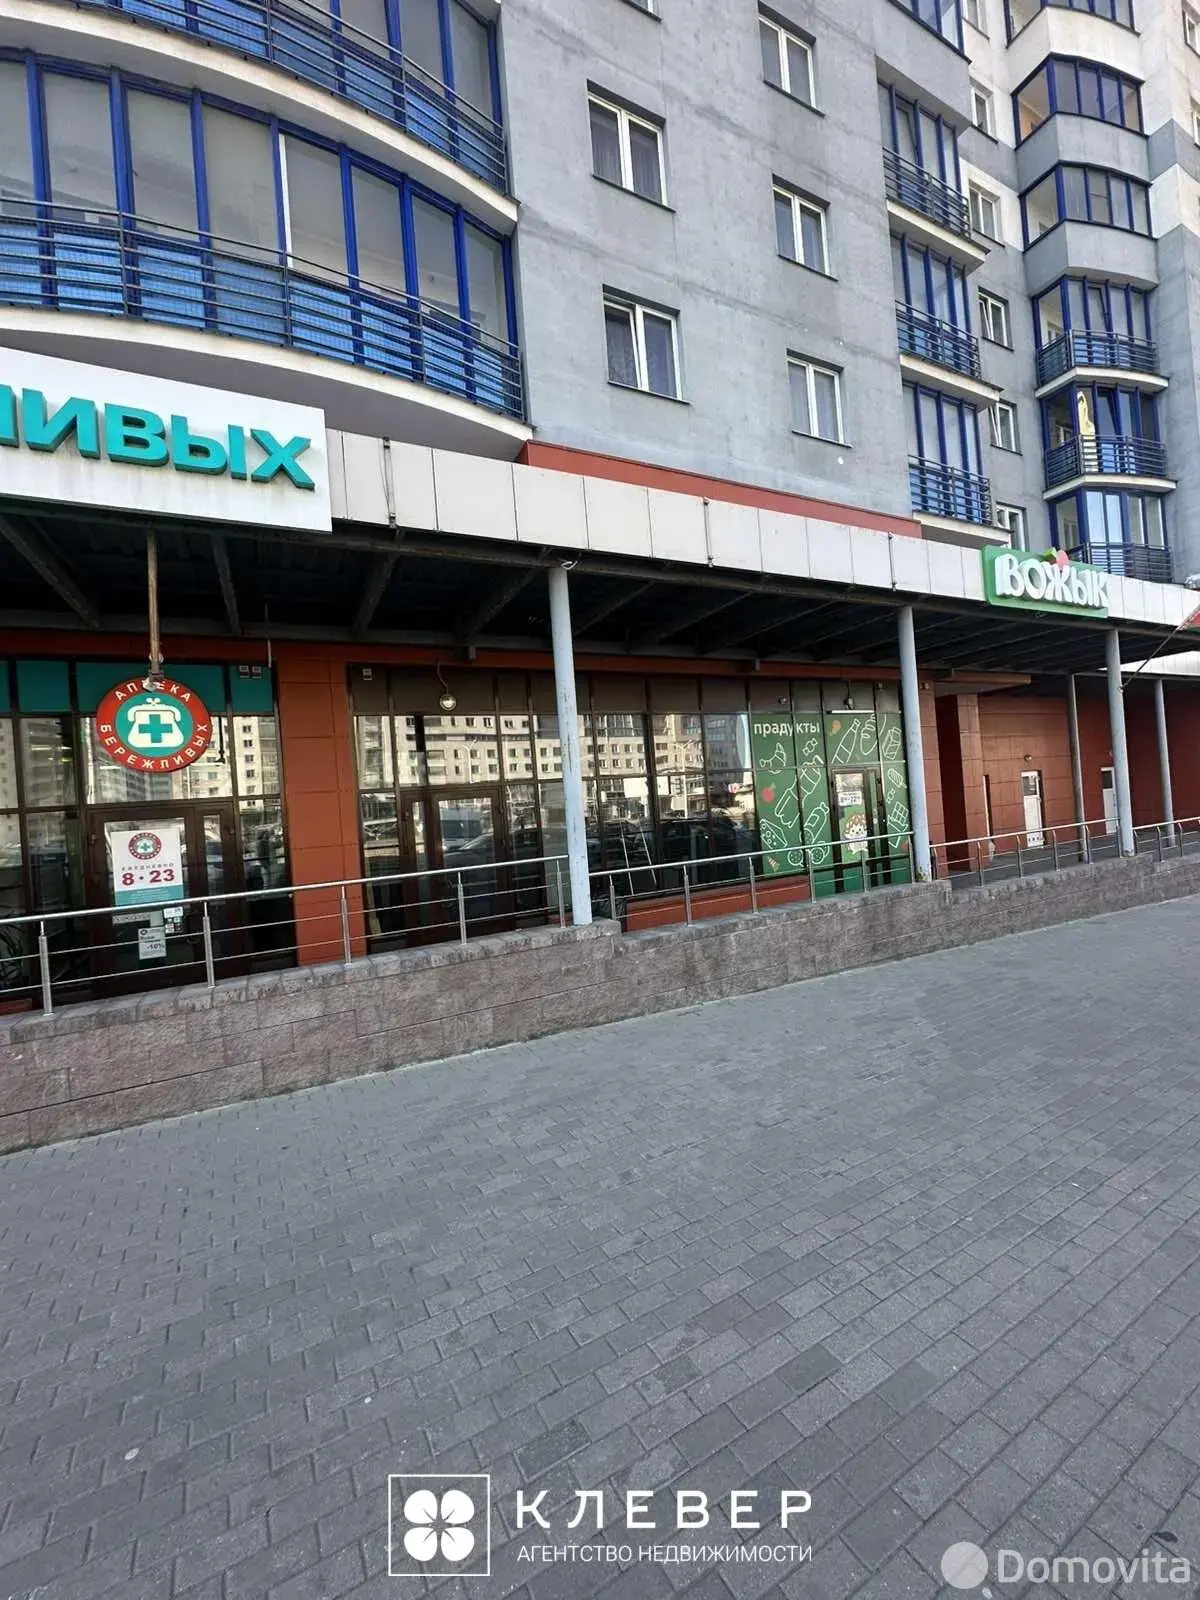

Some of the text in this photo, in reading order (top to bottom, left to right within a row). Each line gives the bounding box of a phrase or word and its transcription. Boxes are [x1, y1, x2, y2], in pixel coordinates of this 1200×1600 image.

[0, 384, 315, 492] ИВЫХ
[115, 679, 191, 702] АПЕКА
[100, 724, 208, 769] БЕРЕЖЛИВЫХ
[754, 721, 820, 738] прадукты
